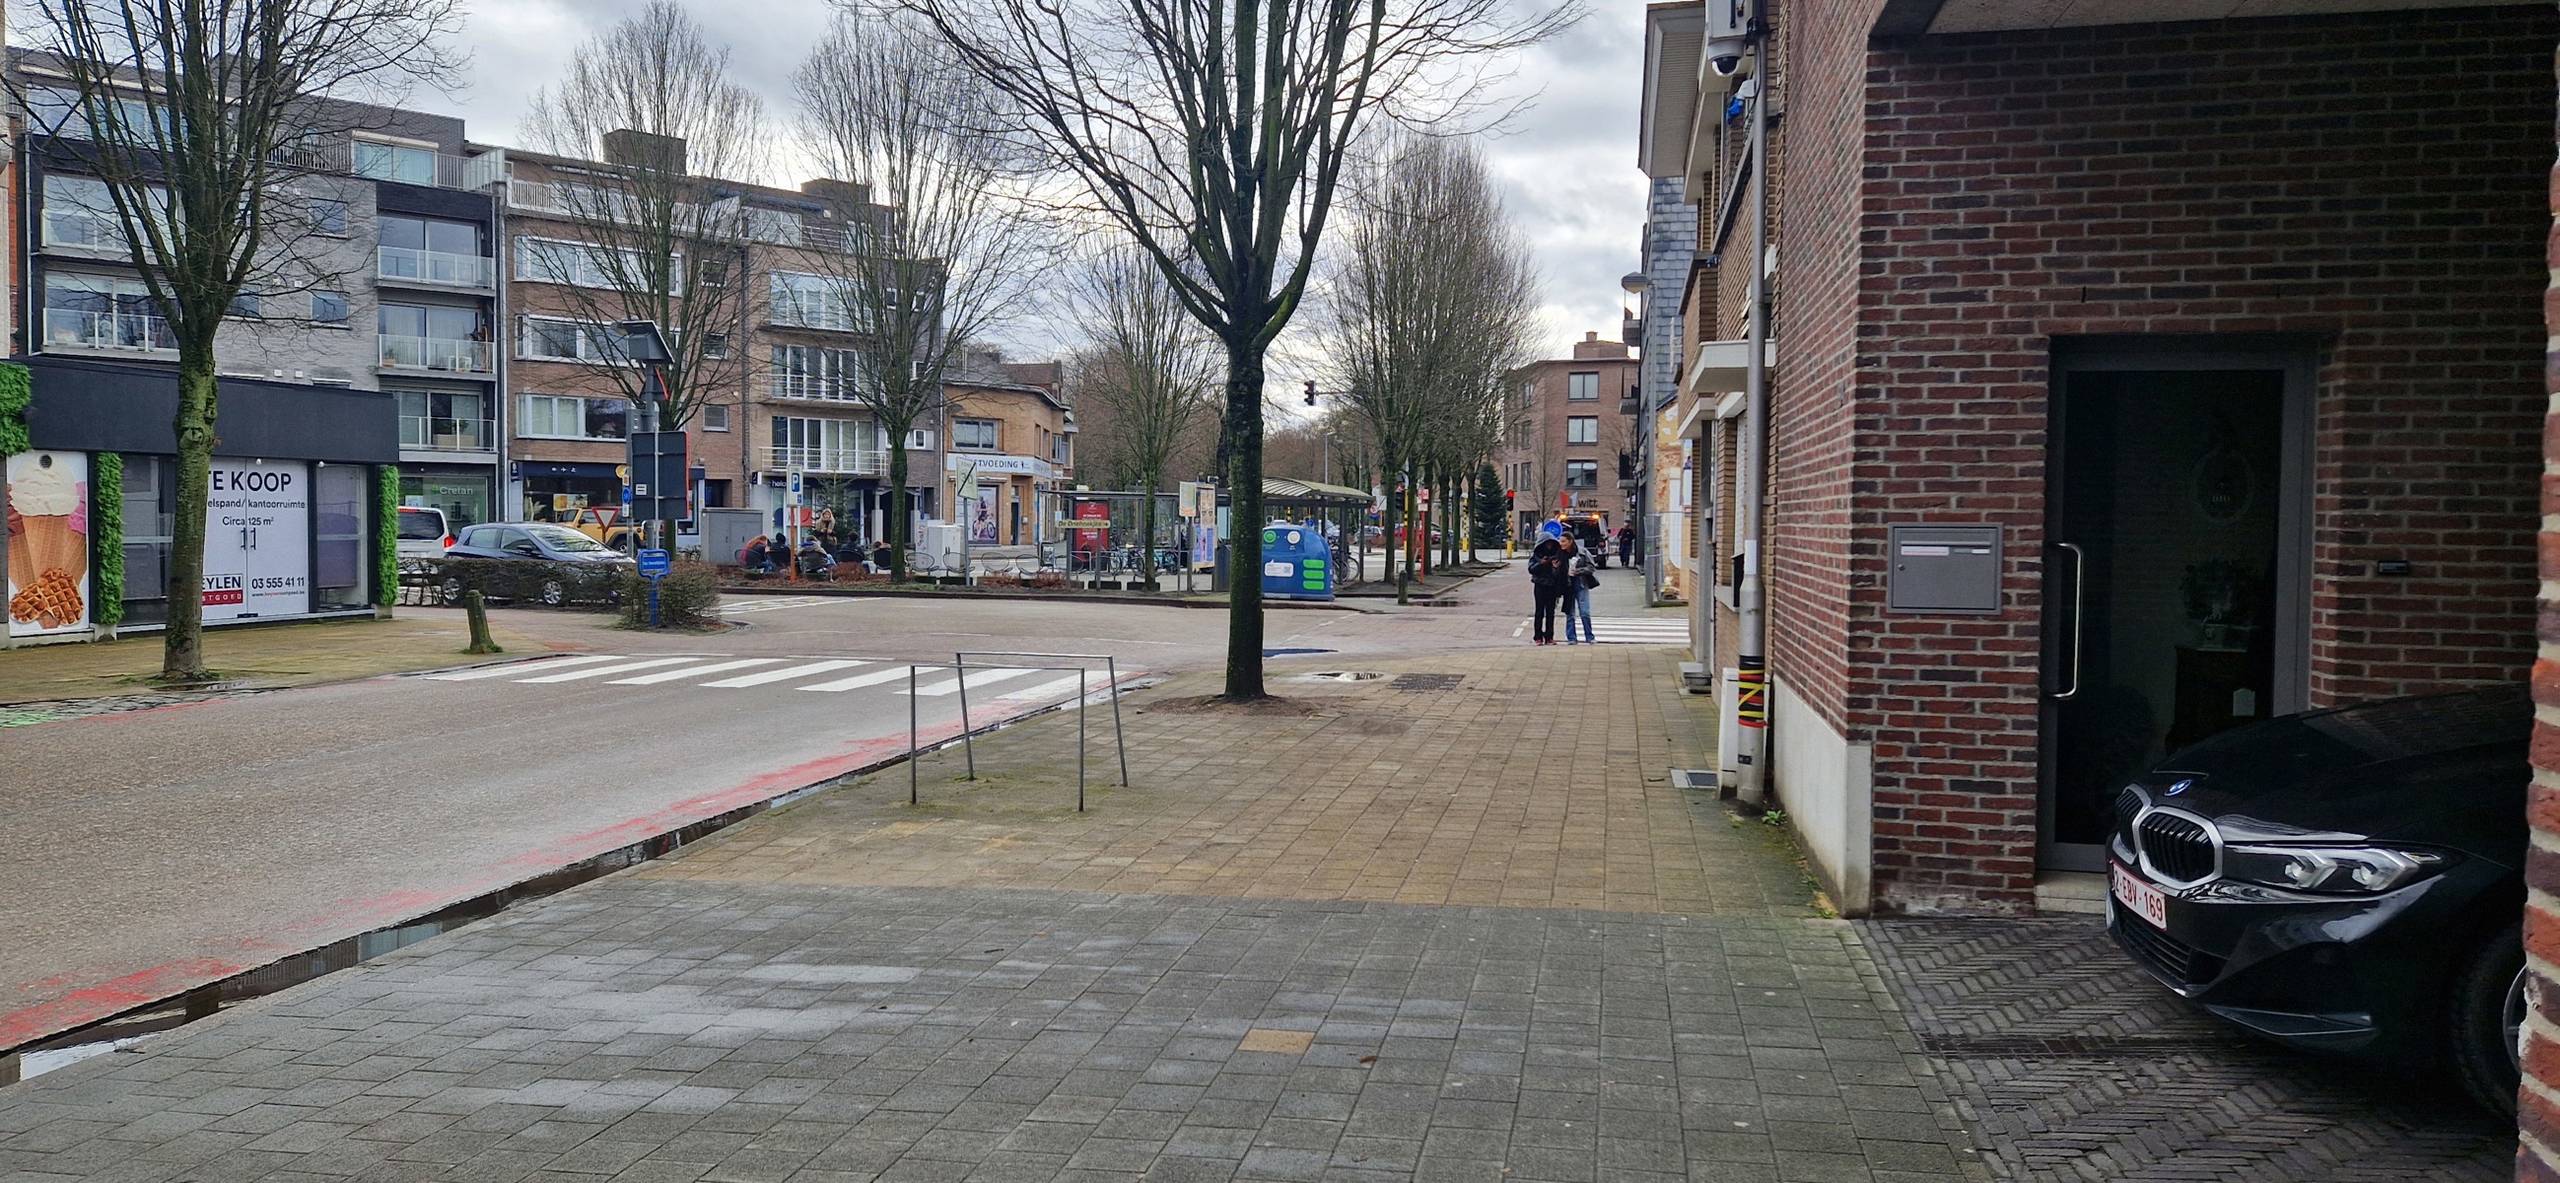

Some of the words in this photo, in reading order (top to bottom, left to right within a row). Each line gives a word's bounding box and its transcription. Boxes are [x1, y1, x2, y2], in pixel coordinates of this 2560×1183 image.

[208, 470, 224, 491] E
[231, 471, 291, 492] KOOP
[248, 500, 306, 509] kantoorruimte
[222, 516, 246, 526] Circa
[248, 517, 262, 526] 125
[252, 578, 264, 589] 03
[266, 578, 283, 588] 555
[285, 577, 295, 587] 41
[297, 577, 305, 587] 11
